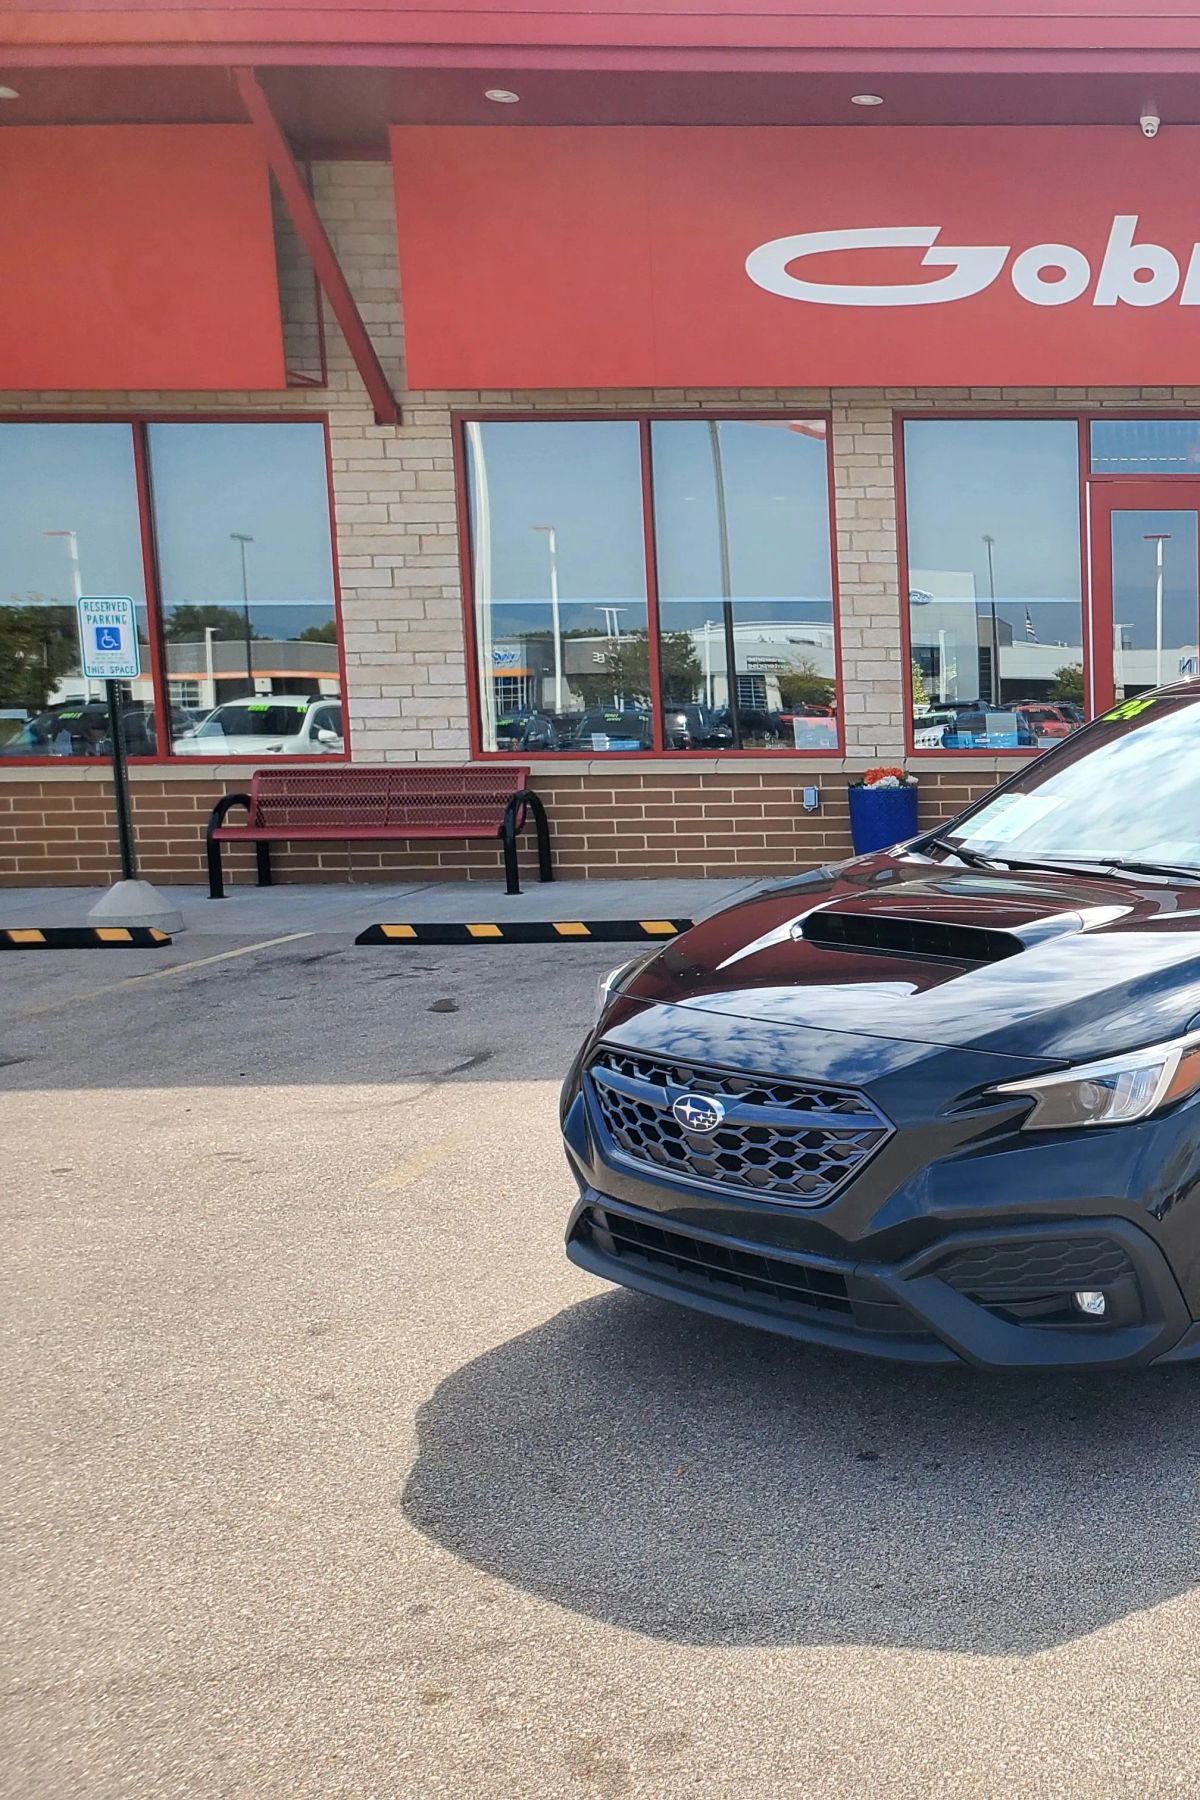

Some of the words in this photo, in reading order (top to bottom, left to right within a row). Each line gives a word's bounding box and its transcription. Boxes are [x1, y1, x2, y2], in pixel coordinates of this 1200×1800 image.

[83, 601, 128, 612] RESERVED
[86, 614, 127, 625] PARKING
[87, 665, 105, 674] THIS
[110, 665, 135, 674] SPACE
[1102, 699, 1157, 721] 24
